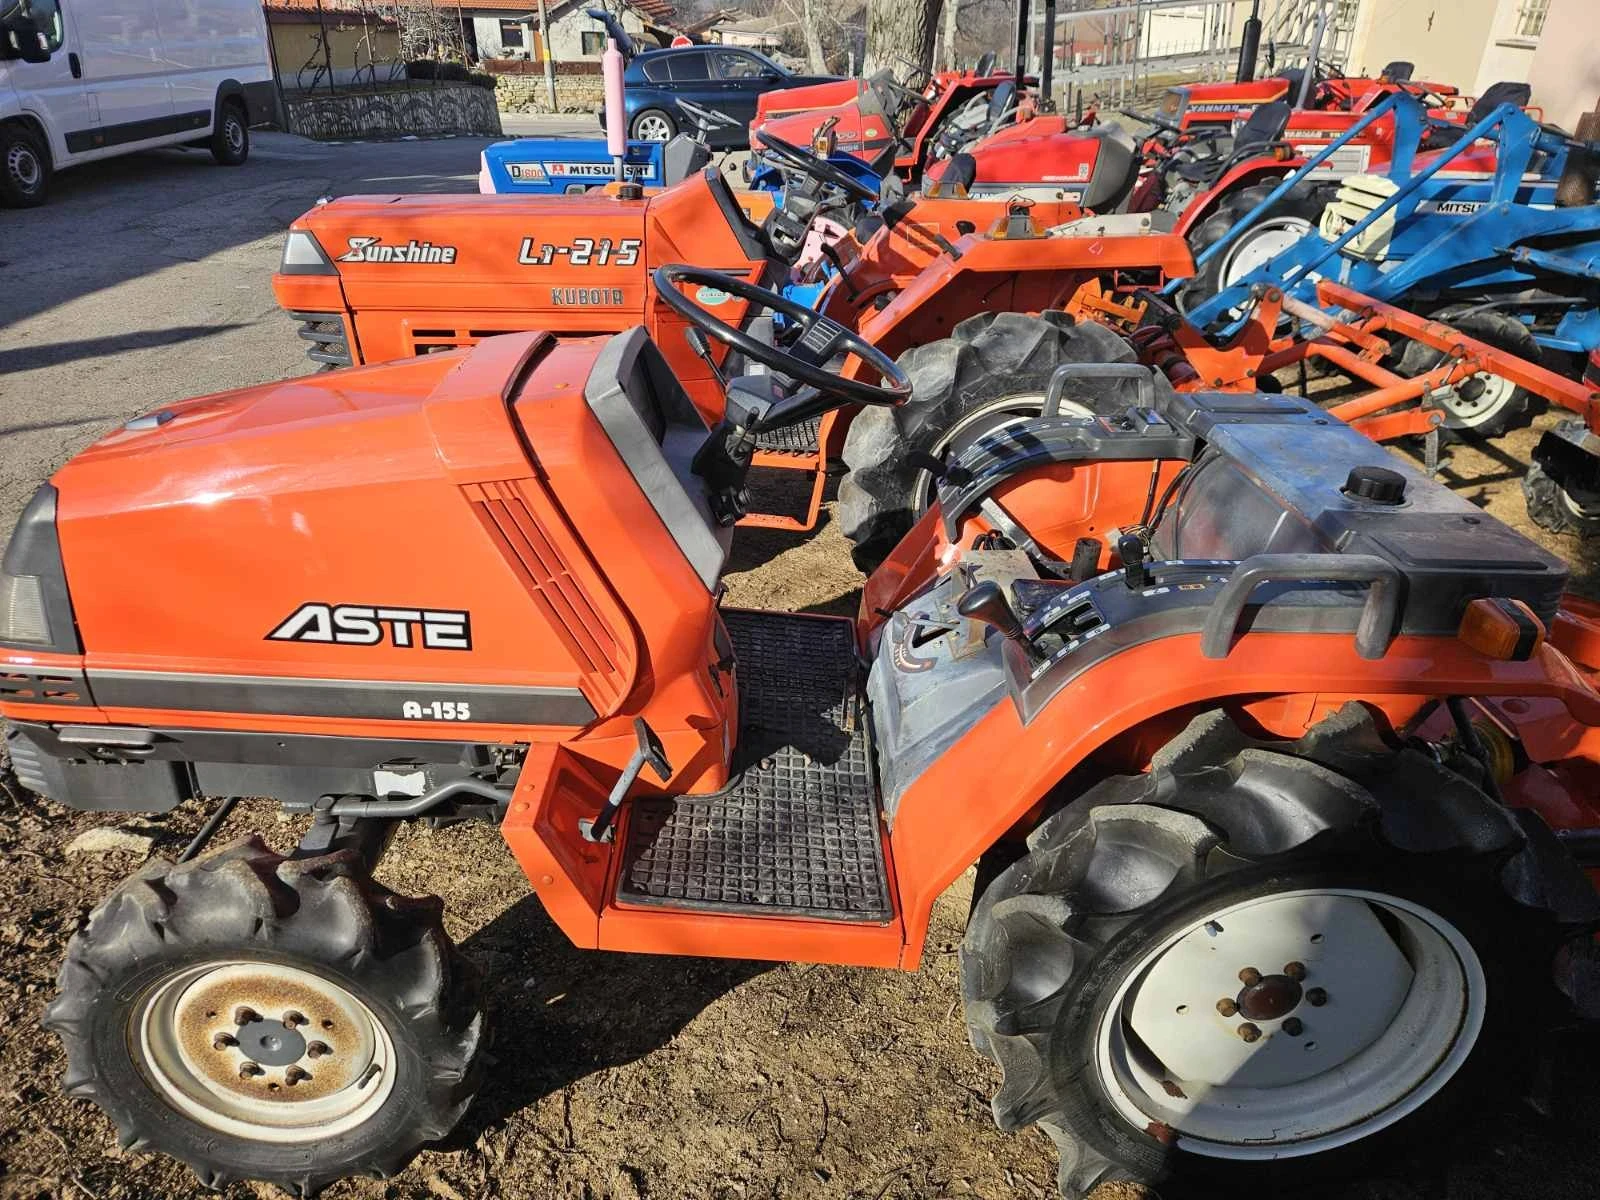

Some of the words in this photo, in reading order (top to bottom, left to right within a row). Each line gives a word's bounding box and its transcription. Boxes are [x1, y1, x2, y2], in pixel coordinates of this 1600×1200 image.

[1191, 104, 1239, 112] YANMAR
[569, 165, 649, 176] MITSUSHI
[334, 236, 457, 264] Sunshine
[551, 287, 624, 305] KUBOTA
[263, 602, 472, 651] ASTE
[402, 700, 471, 721] A-155
